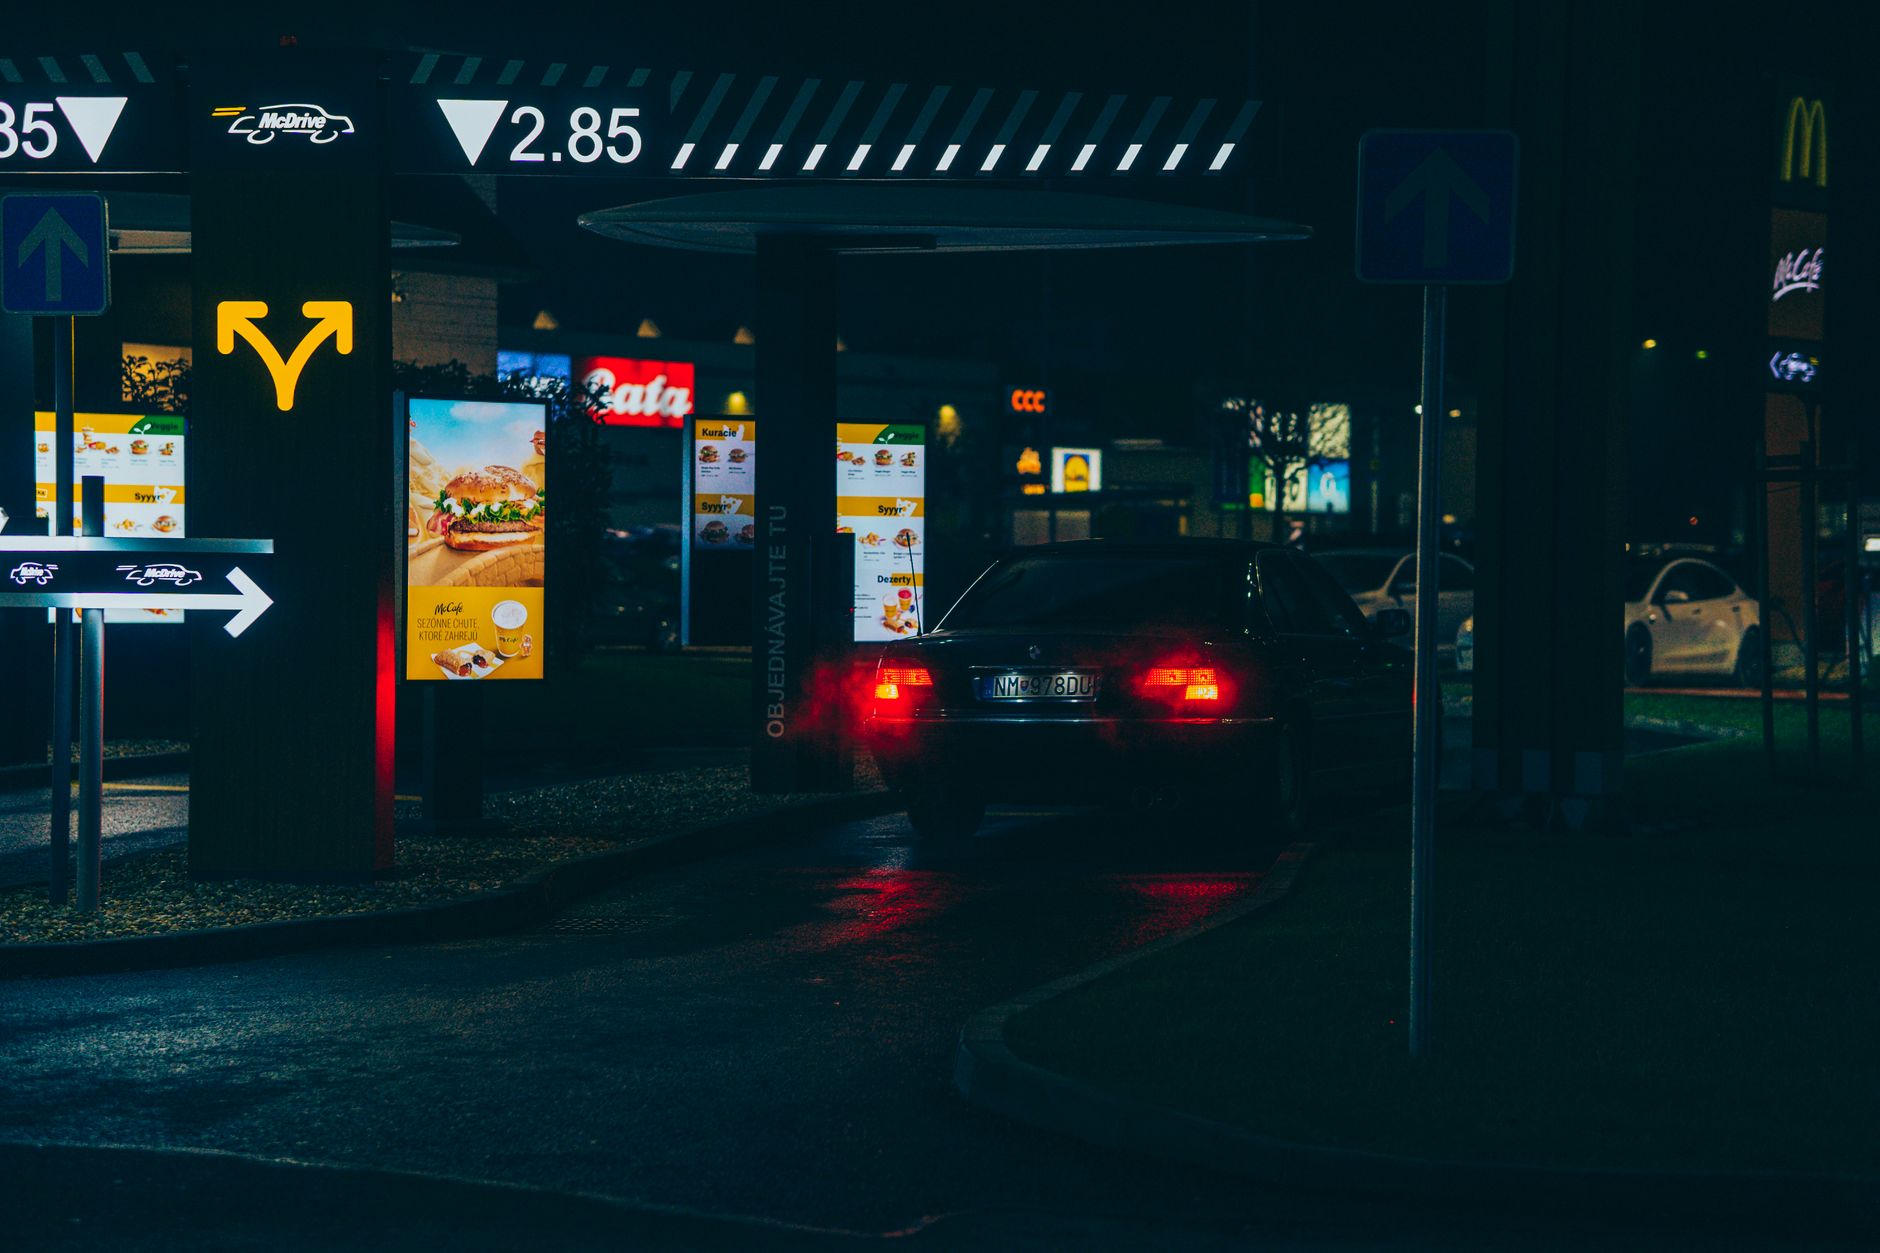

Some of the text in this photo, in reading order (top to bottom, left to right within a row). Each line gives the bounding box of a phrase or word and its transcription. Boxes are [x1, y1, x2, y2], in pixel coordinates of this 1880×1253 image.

[258, 112, 327, 129] McDrive
[509, 105, 642, 164] 2.85
[1011, 388, 1046, 413] CCC
[702, 428, 737, 438] Kuracie
[143, 568, 186, 578] McDrive
[877, 575, 911, 586] Dezerty
[765, 505, 787, 738] OBJEDNÁVAJTE TU
